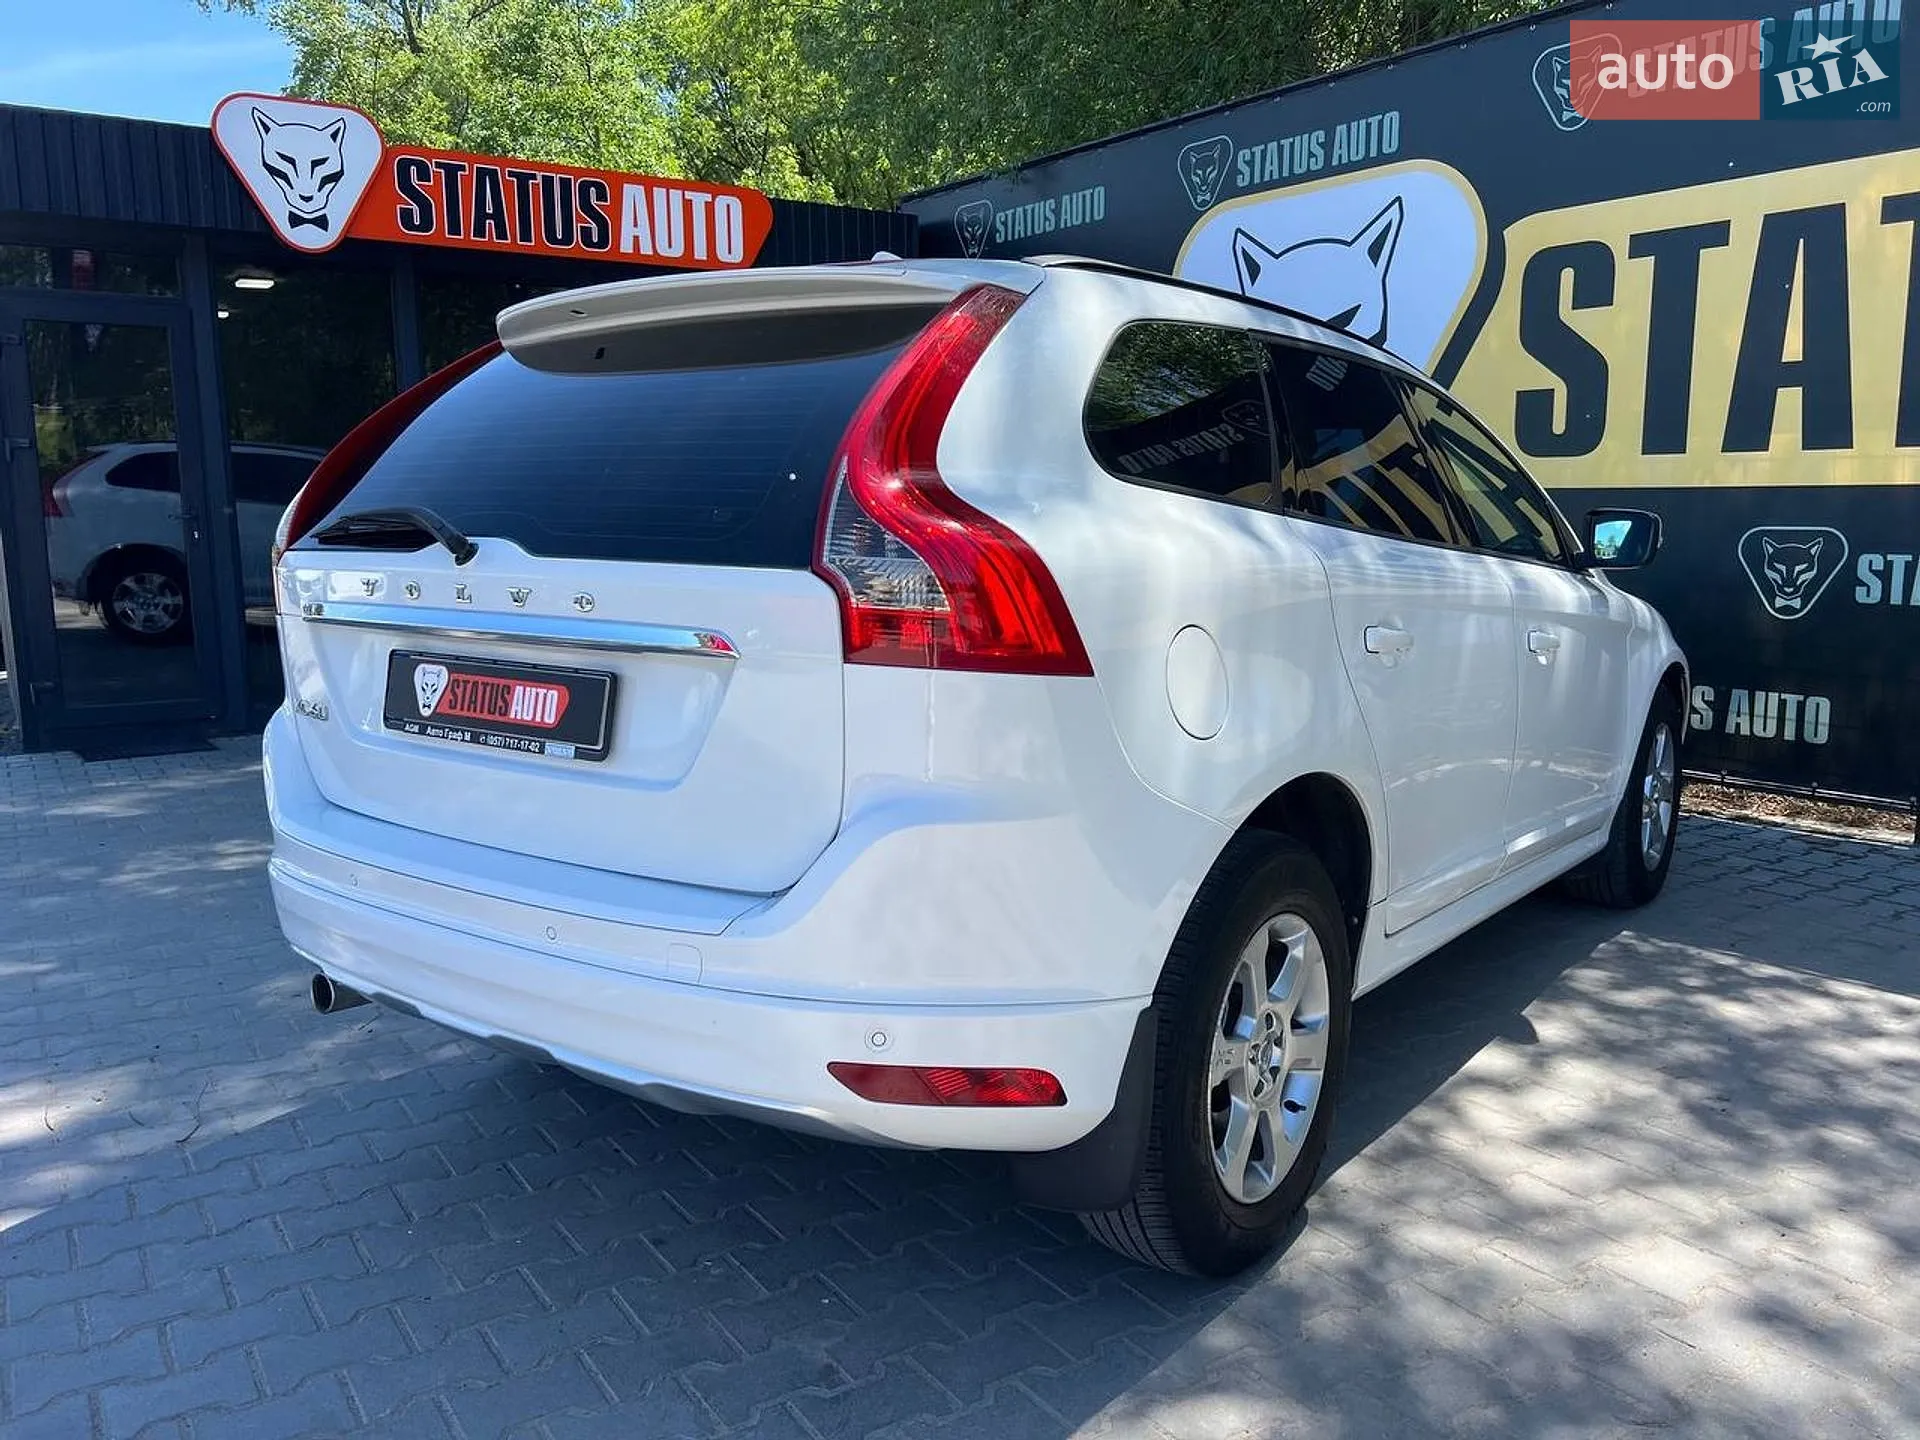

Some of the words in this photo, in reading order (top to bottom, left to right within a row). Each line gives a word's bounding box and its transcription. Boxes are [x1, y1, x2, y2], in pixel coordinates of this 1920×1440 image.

[1236, 132, 1325, 188] STATUS
[1332, 110, 1400, 167] AUTO
[394, 155, 612, 253] STATUS
[619, 183, 744, 264] AUTO
[995, 197, 1056, 243] STATUS
[1061, 185, 1106, 227] AUTO
[360, 577, 595, 613] VOLVO
[449, 678, 511, 717] STATUS
[510, 685, 559, 724] AUTO
[1725, 689, 1831, 744] AUTO
